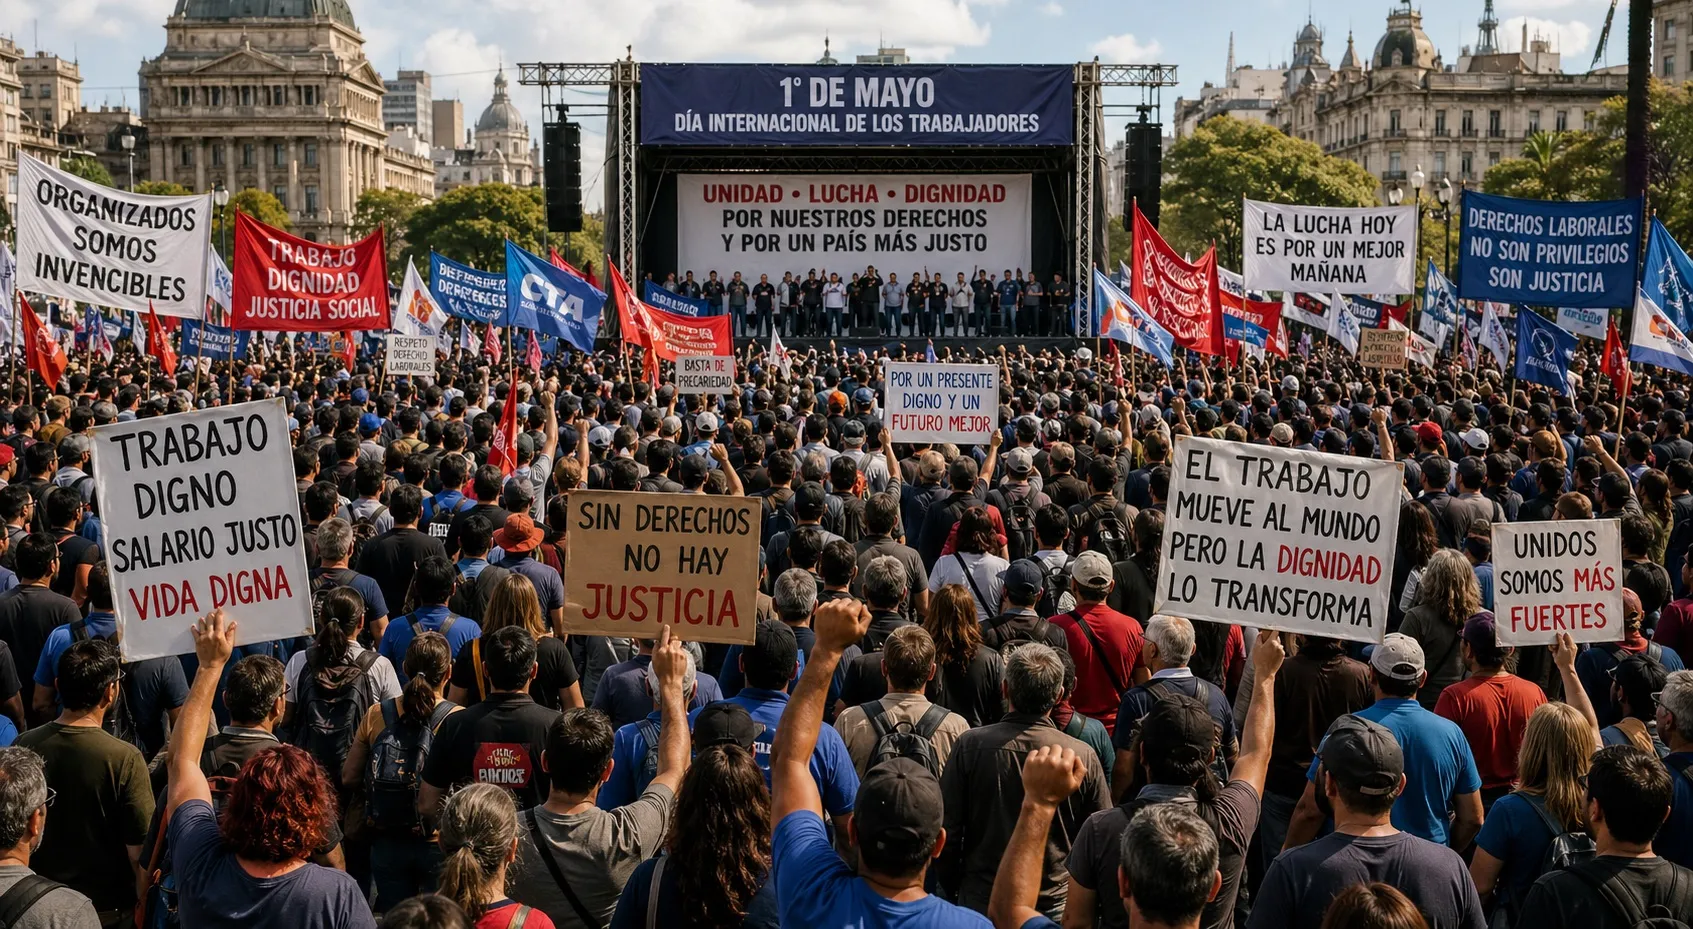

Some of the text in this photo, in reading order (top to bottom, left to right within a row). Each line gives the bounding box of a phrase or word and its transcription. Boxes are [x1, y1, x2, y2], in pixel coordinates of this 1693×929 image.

[810, 77, 844, 107] DE
[855, 77, 934, 107] MAYO
[675, 109, 1039, 132] DÍA INTERNACIONAL DE LOS TRABAJADORES
[37, 178, 196, 231] ORGANIZADOS
[704, 184, 1005, 204] UNIDAD LUCHA DIGNIDAD
[723, 209, 986, 227] POR NUESTROS DERECHOS
[1264, 212, 1396, 234] LA LUCHA HOY
[1469, 208, 1632, 236] DERECHOS LABORALES
[73, 226, 156, 263] SOMOS
[268, 238, 357, 268] TRABAJO
[721, 229, 987, 252] Y POR UN PAÍS MÁS JUSTO
[1256, 237, 1404, 258] ES POR UN MEJOR
[1471, 236, 1628, 264] NO SON PRIVILEGIOS
[35, 252, 185, 302] INVENCIBLES
[266, 267, 360, 297] DIGNIDAD
[1291, 261, 1366, 283] MAÑANA
[1489, 267, 1604, 292] SON JUSTICIA
[246, 296, 380, 320] JUSTICIA SOCIAL
[521, 274, 584, 324] CTA
[395, 335, 427, 348] RESPETO
[685, 359, 725, 371] BASTA DE
[679, 375, 732, 387] PRECARIEDAD
[891, 372, 992, 388] POR UN PRESENTE
[904, 393, 979, 409] DIGNO Y UN
[892, 414, 991, 432] FUTURO MEJOR
[110, 412, 267, 471] TRABAJO
[1186, 450, 1370, 500] EL TRABAJO
[134, 470, 236, 519] DIGNO
[579, 502, 750, 535] SIN DERECHOS
[1176, 491, 1380, 543] MUEVE AL MUNDO
[112, 514, 296, 573] SALARIO JUSTO
[1170, 532, 1381, 584] PERO LA DIGNIDAD
[1515, 531, 1596, 558] UNIDOS
[624, 544, 728, 575] NO HAY
[129, 565, 293, 620] VIDA DIGNA
[1500, 561, 1615, 595] SOMOS MÁS
[582, 584, 739, 627] JUSTICIA
[1168, 573, 1372, 627] LO TRANSFORMA
[1511, 603, 1606, 632] FUERTES
